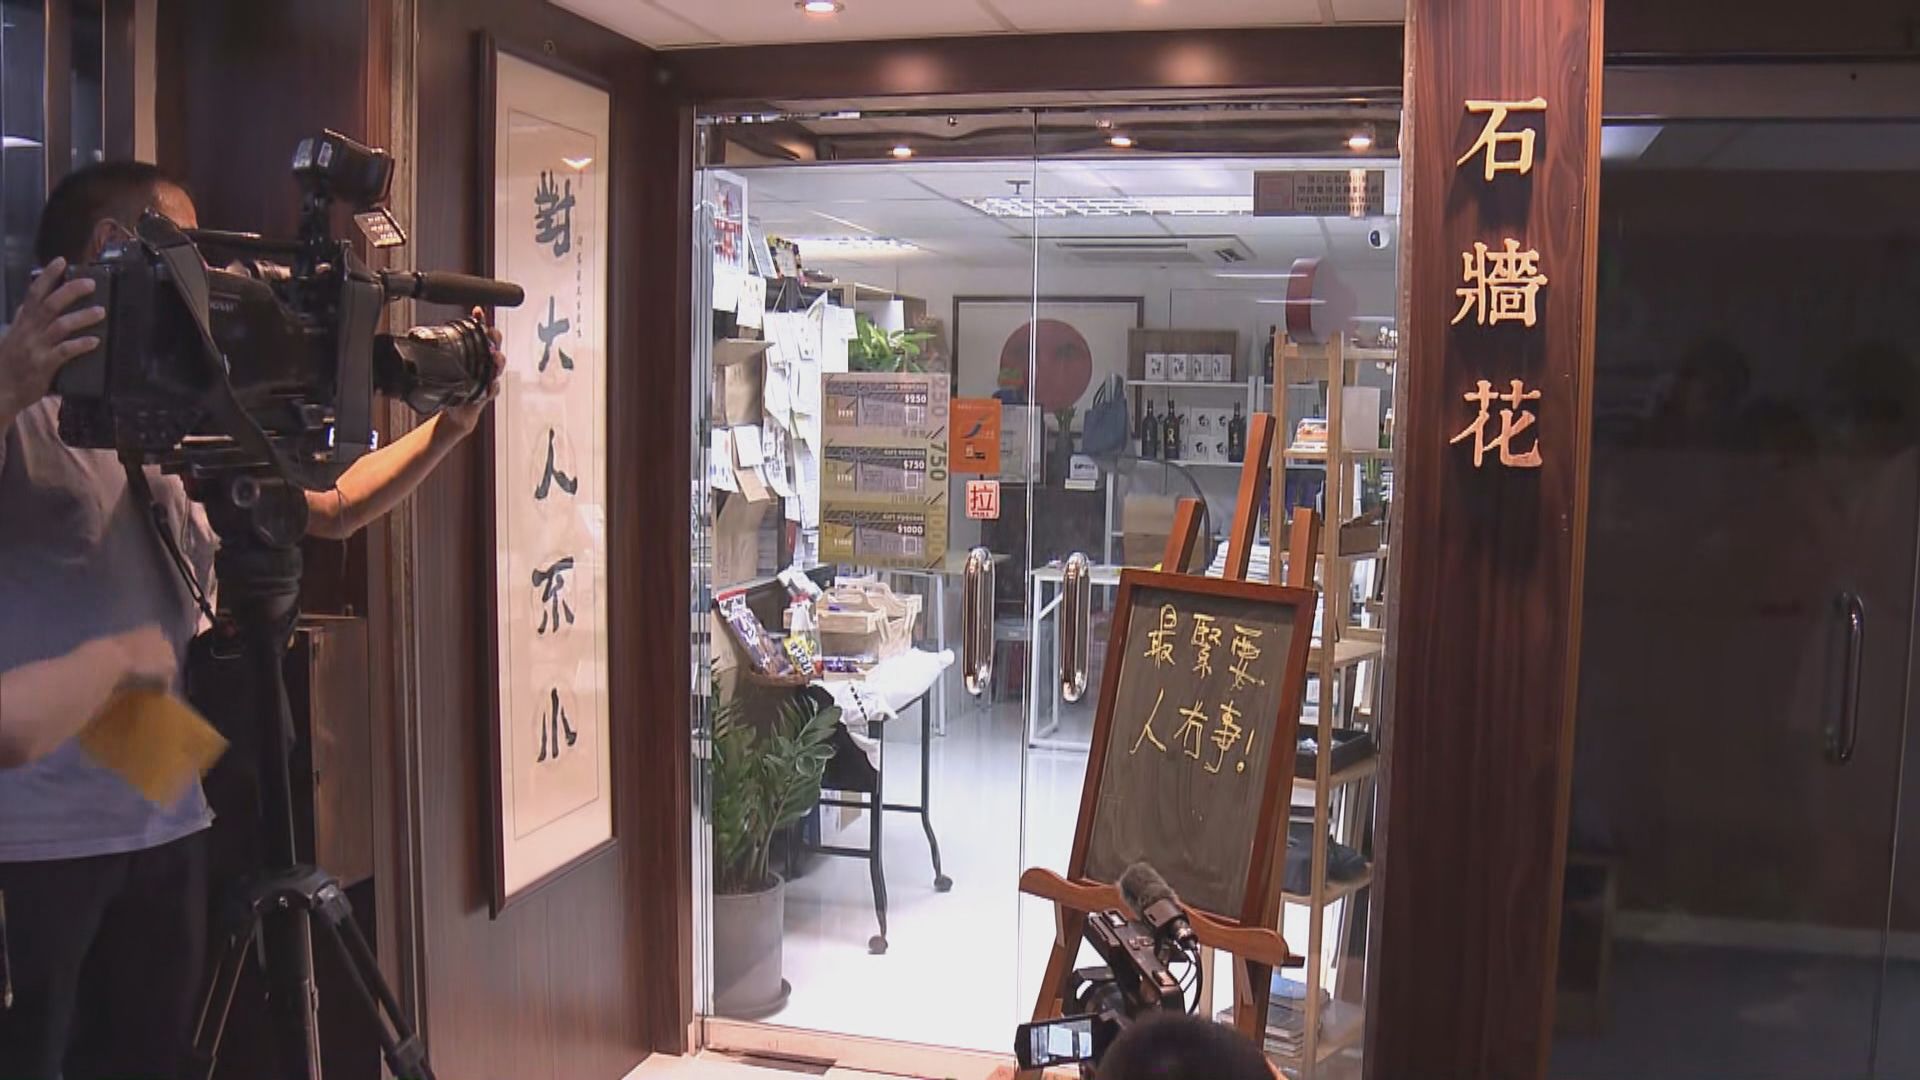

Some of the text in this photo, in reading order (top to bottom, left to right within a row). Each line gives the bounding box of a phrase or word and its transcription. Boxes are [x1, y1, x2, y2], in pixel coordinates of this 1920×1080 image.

[1449, 96, 1549, 468] 石牆花
[904, 394, 927, 403] $250
[903, 459, 925, 469] $750
[930, 441, 947, 482] 750
[970, 483, 994, 511] 拉
[897, 524, 924, 534] $1000
[1144, 604, 1265, 691] 最緊要
